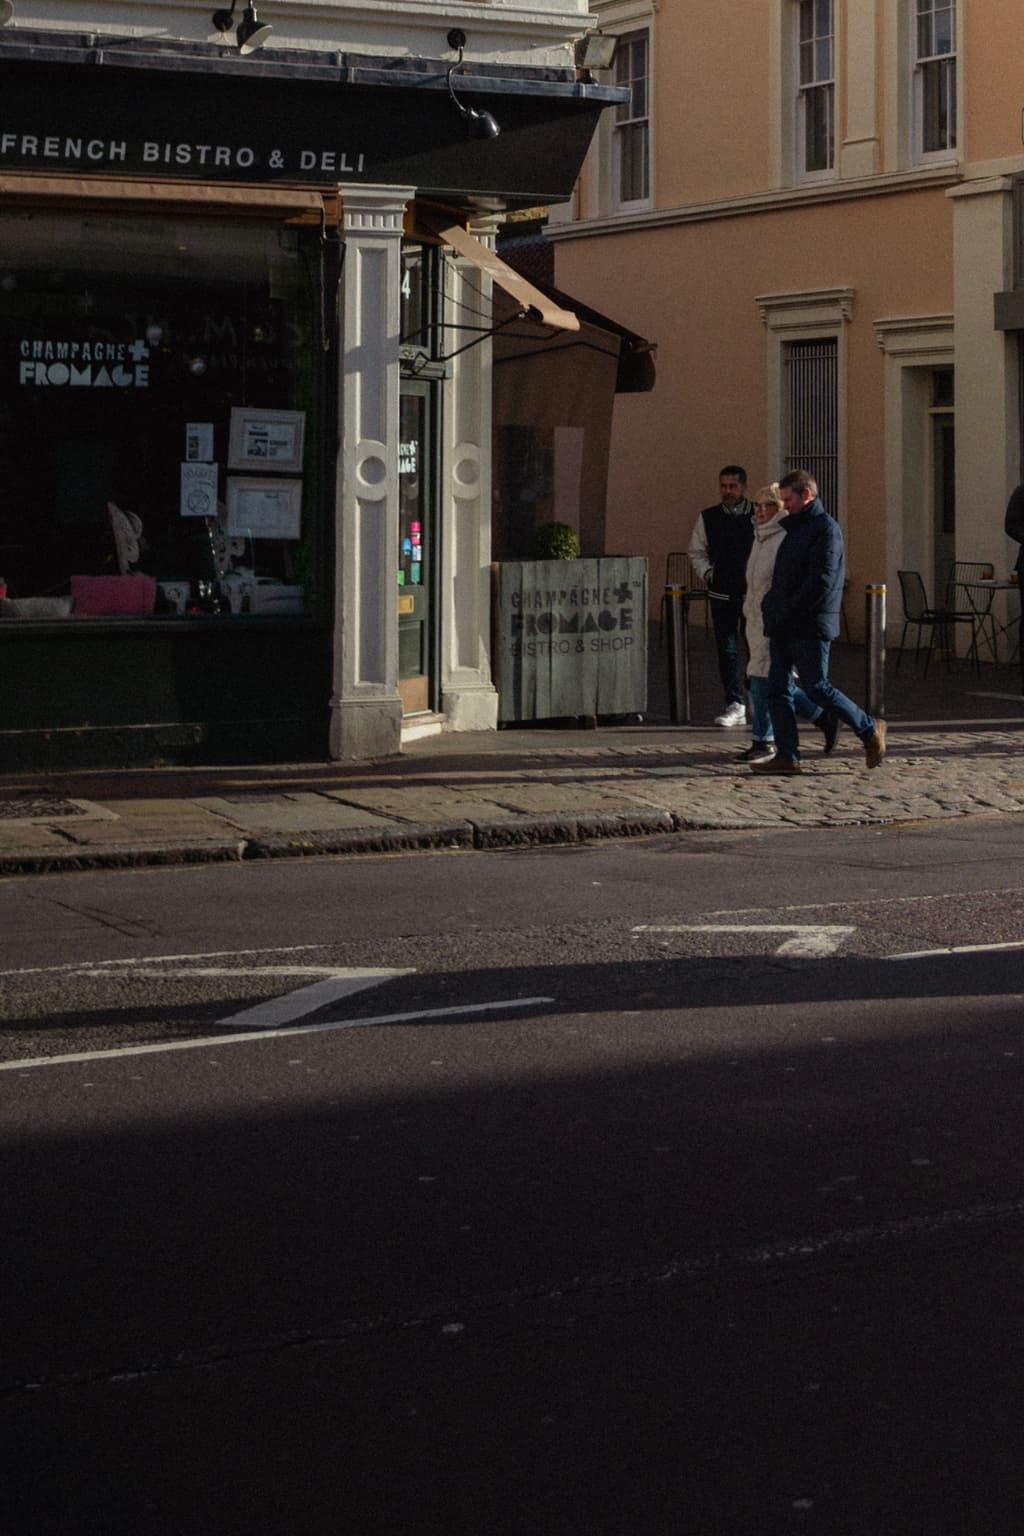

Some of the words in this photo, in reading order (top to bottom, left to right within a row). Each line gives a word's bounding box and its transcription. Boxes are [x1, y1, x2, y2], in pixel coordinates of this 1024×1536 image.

[0, 134, 127, 161] FRENCH
[143, 143, 256, 168] BISTRO
[269, 149, 286, 169] &
[300, 151, 365, 173] DELI
[19, 361, 150, 387] FROMAGE
[510, 608, 633, 637] FROMAGE
[511, 639, 570, 657] BISTRO
[575, 639, 585, 653] &
[590, 636, 634, 652] SHOP
